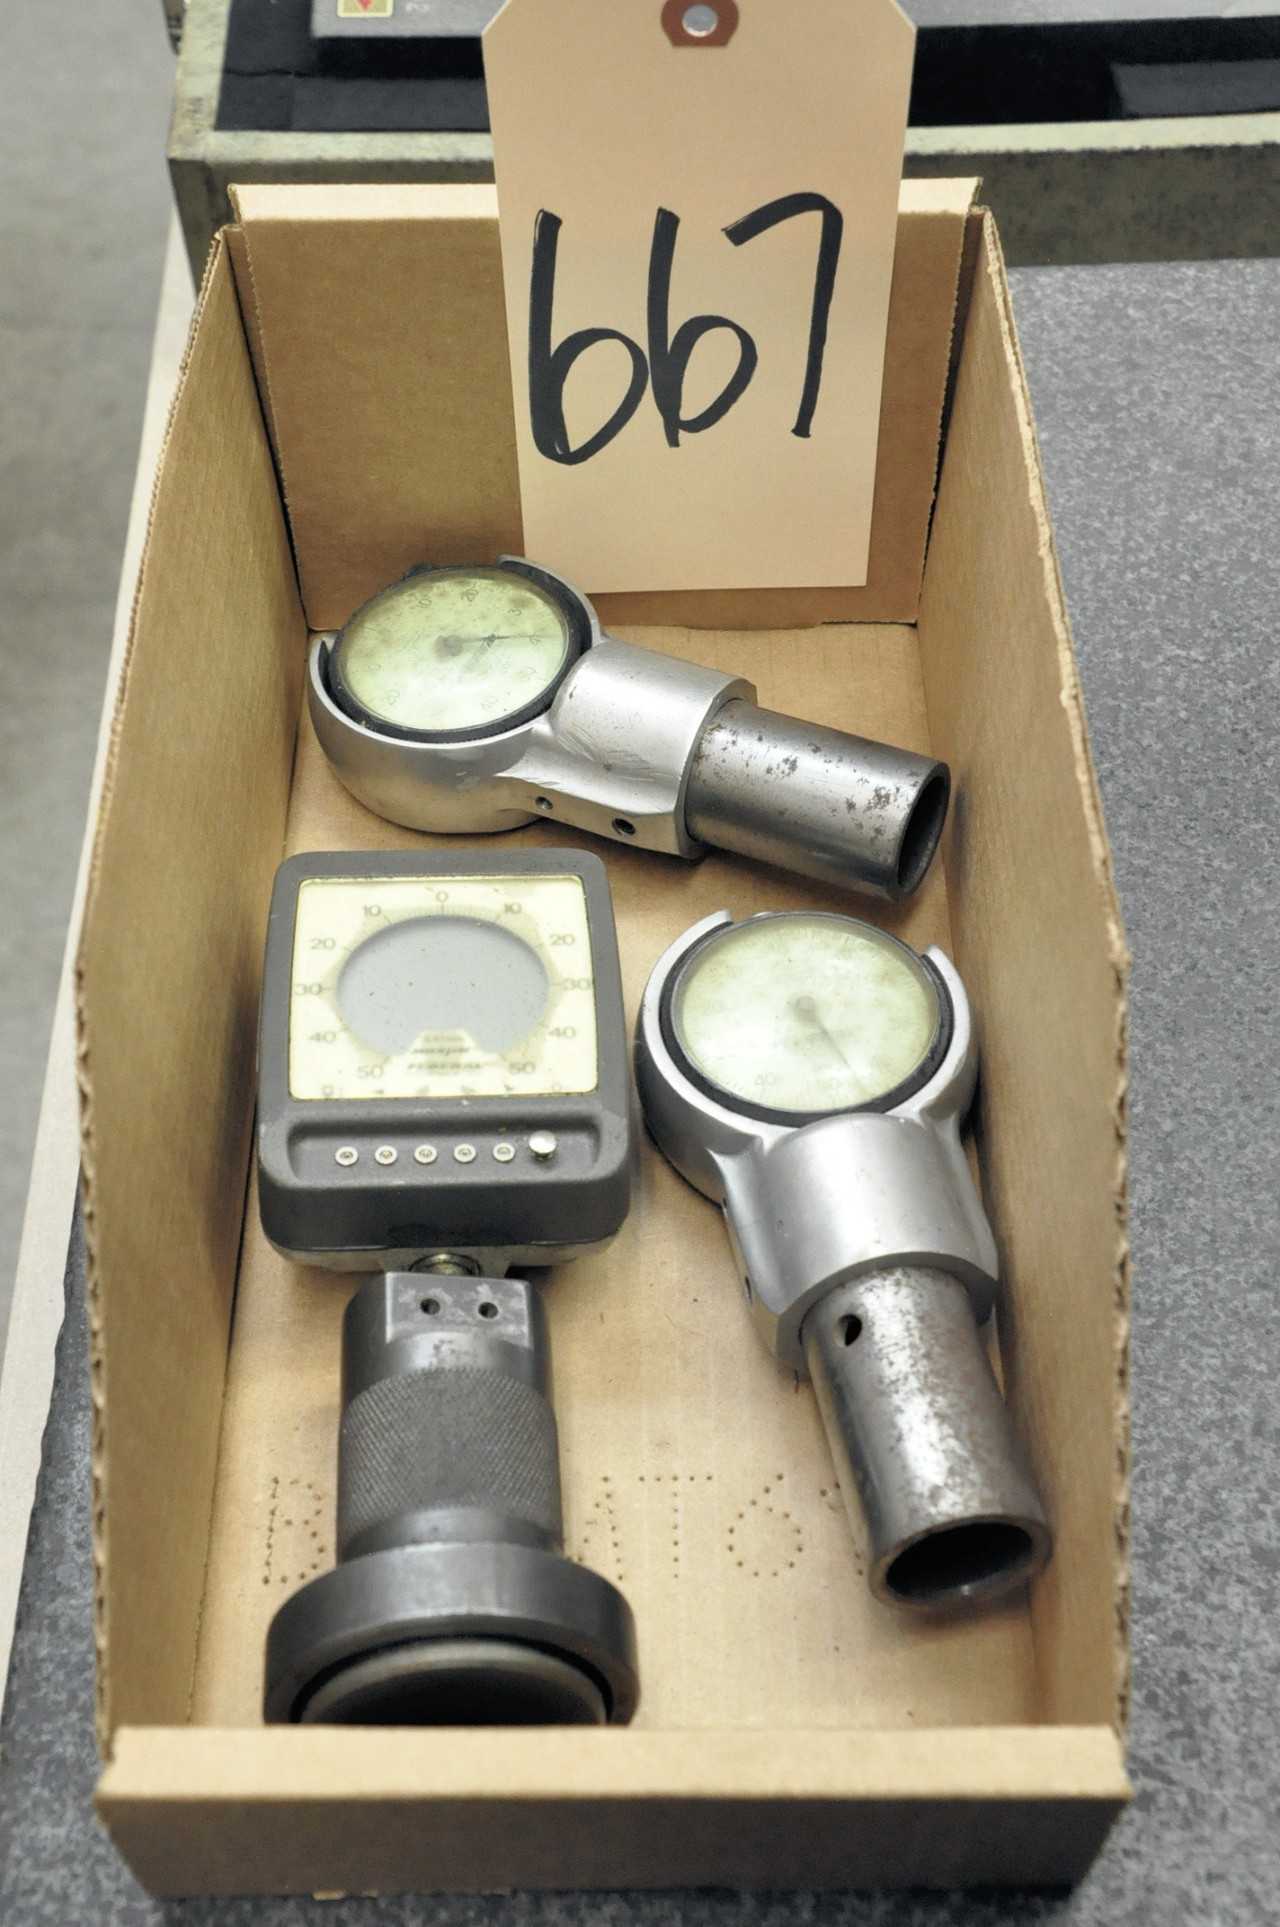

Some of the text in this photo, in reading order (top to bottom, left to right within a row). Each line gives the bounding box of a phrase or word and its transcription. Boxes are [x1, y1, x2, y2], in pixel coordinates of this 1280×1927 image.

[528, 192, 843, 465] 667
[436, 890, 449, 904] 0
[363, 904, 382, 918] 10
[503, 902, 523, 916] 10
[310, 937, 337, 951] 20
[550, 933, 576, 947] 20
[295, 983, 323, 996] 30
[563, 978, 591, 992] 30
[308, 1031, 338, 1044] 40
[549, 1026, 577, 1040] 40
[356, 1064, 385, 1079] 50
[509, 1061, 537, 1075] 50
